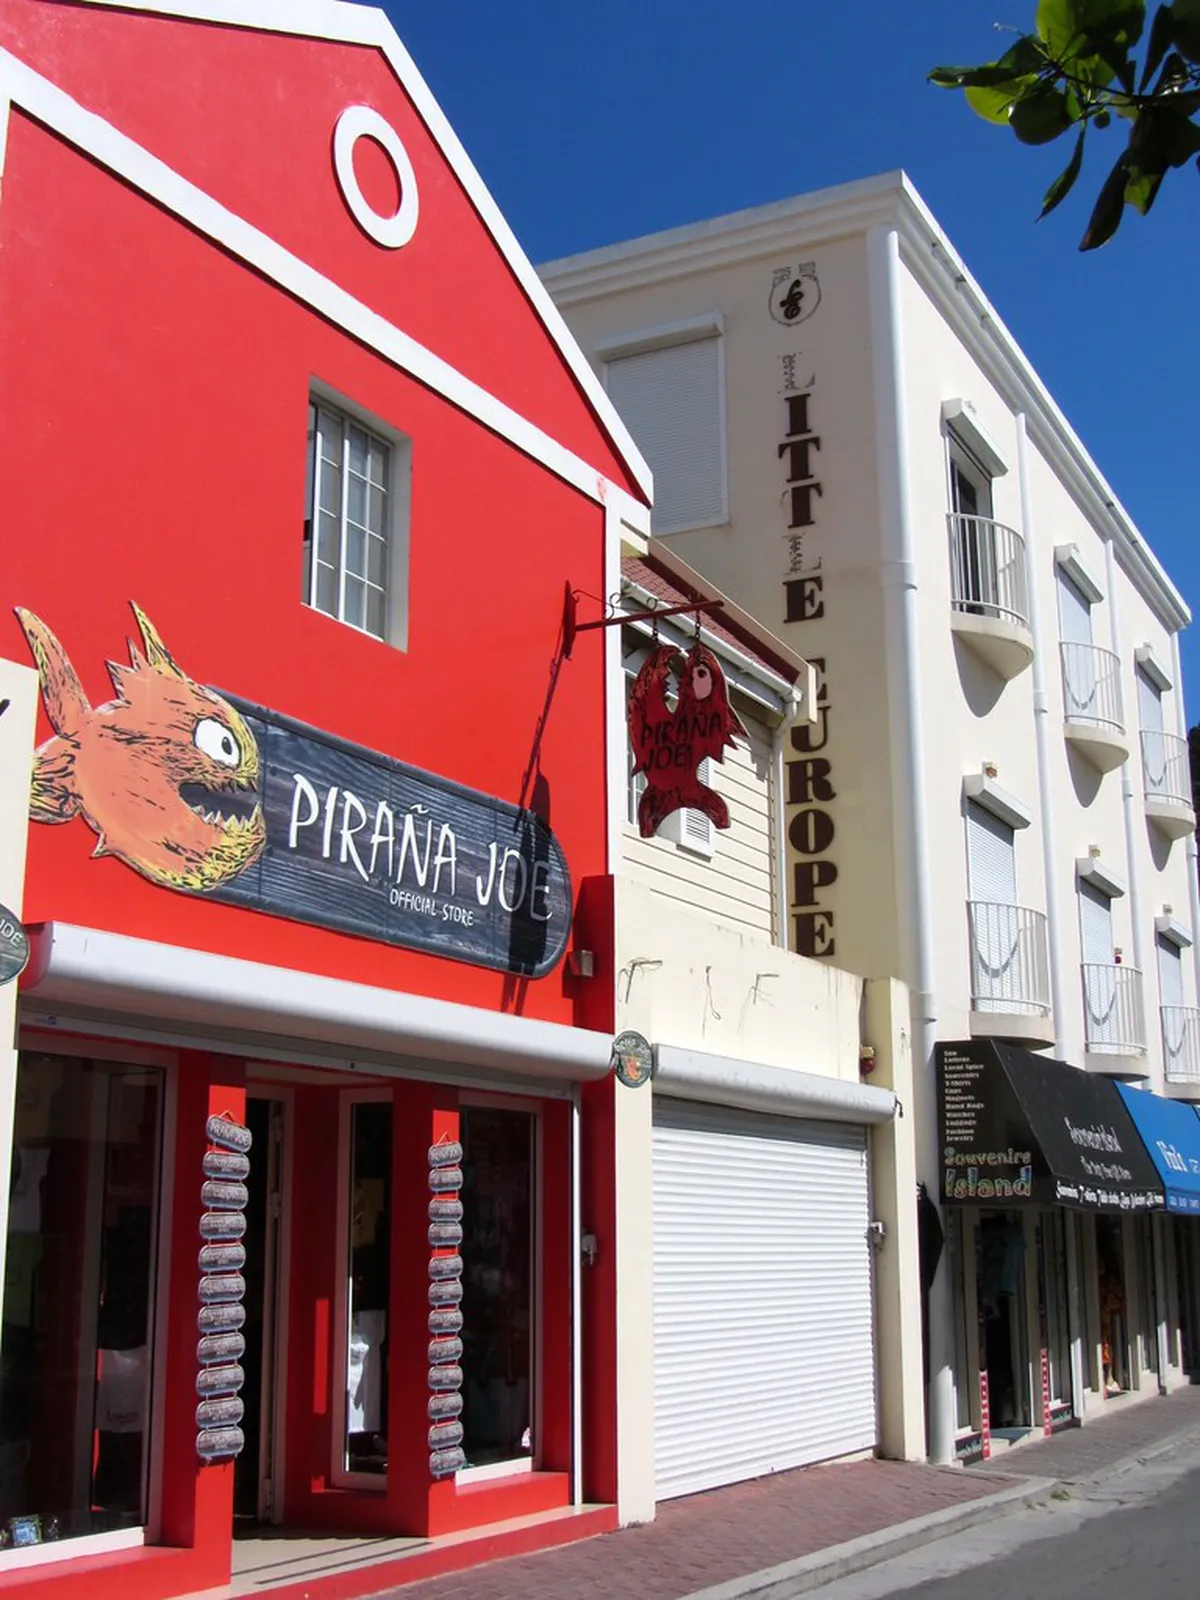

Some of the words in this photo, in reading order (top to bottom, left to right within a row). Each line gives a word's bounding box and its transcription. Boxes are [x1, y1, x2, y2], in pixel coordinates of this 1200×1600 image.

[288, 773, 457, 897] PIRAÑA
[475, 841, 553, 922] JOE
[389, 888, 436, 917] OFFICIAL
[442, 903, 475, 927] STORE
[944, 1165, 1032, 1199] Island
